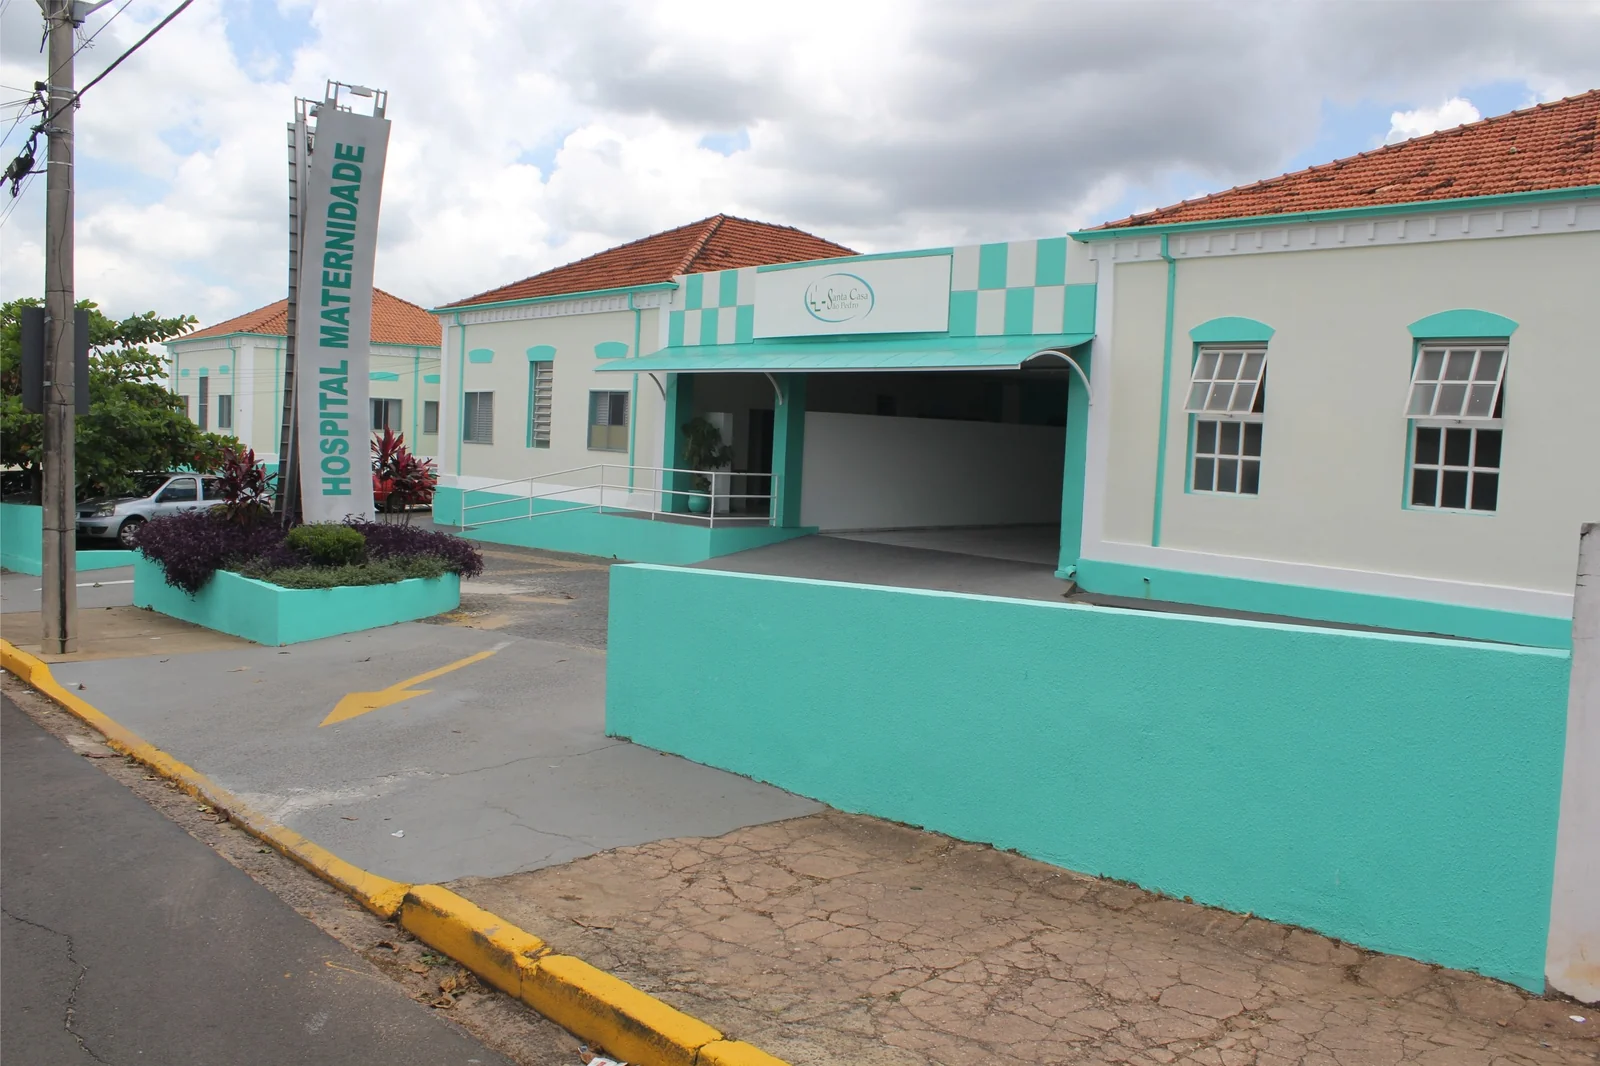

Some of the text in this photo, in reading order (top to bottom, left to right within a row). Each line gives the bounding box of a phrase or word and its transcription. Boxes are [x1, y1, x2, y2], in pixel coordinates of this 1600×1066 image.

[827, 288, 868, 305] Santa Casa
[840, 301, 859, 309] Pedro
[319, 142, 365, 496] HOSPITAL MATERNIDADE
